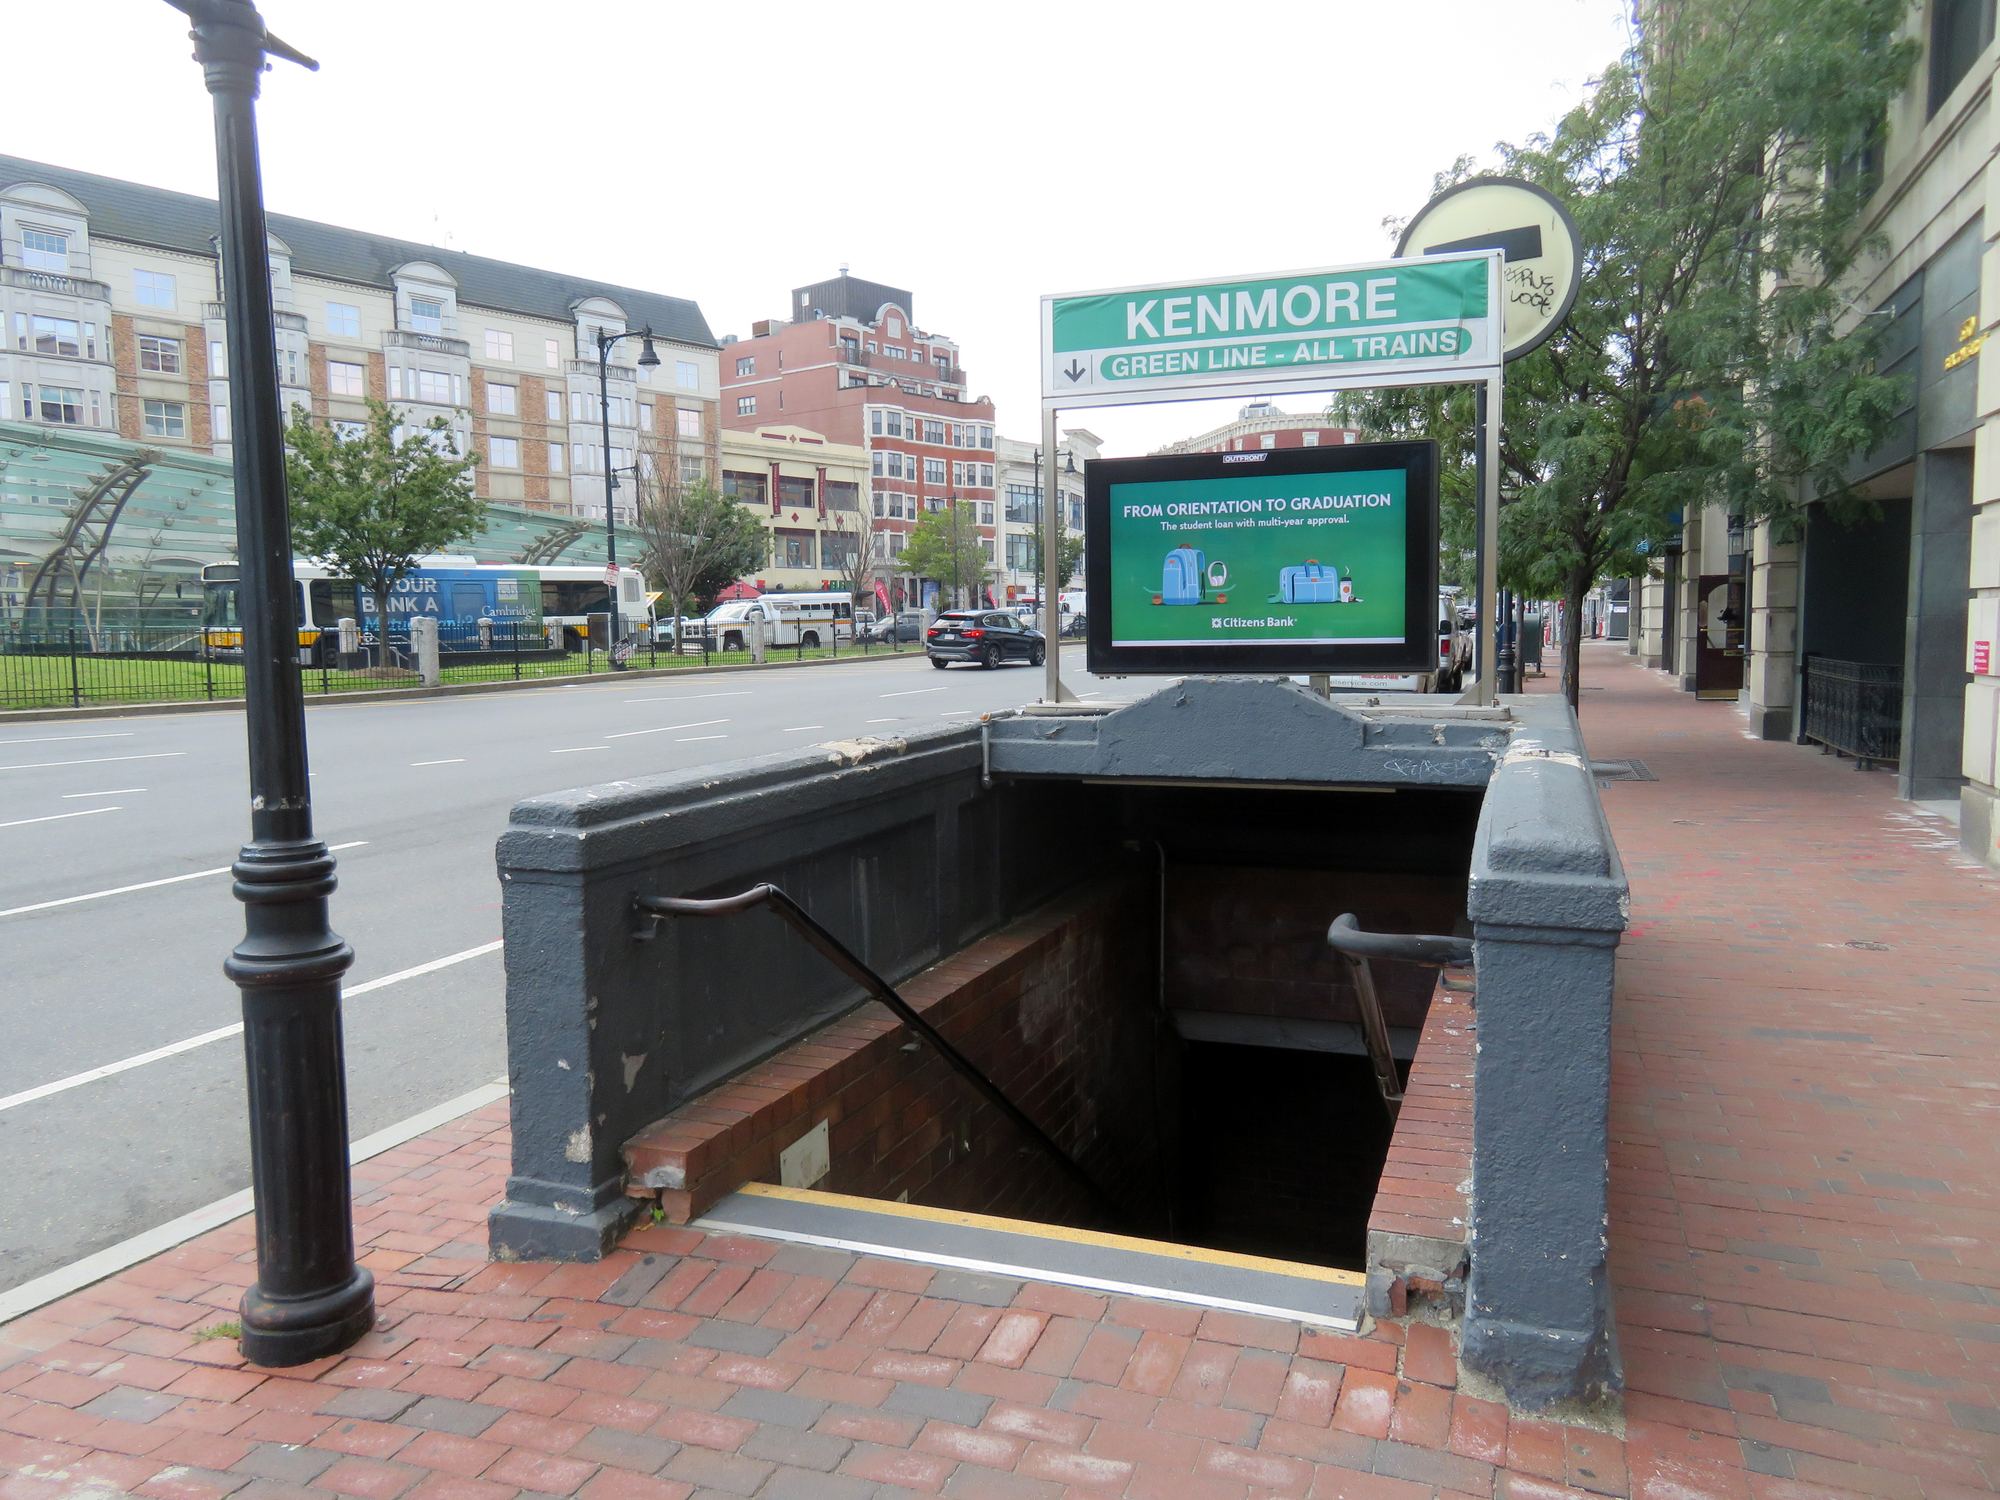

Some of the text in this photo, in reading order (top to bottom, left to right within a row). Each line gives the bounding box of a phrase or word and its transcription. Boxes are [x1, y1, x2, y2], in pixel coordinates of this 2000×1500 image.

[1126, 276, 1398, 340] KENMORE
[1111, 351, 1199, 377] GREEN
[1208, 345, 1266, 370] LINE
[1292, 339, 1344, 363] ALL
[1351, 330, 1458, 359] TRAINS
[1224, 454, 1265, 463] OUTFRONT
[1123, 493, 1391, 518] FROM ORIENTATION TO GRADUATION
[1160, 513, 1350, 531] The student loan with multi-year approval.
[425, 596, 439, 612] A
[481, 603, 537, 620] Cambridge
[1223, 615, 1294, 628] Citizens Bank
